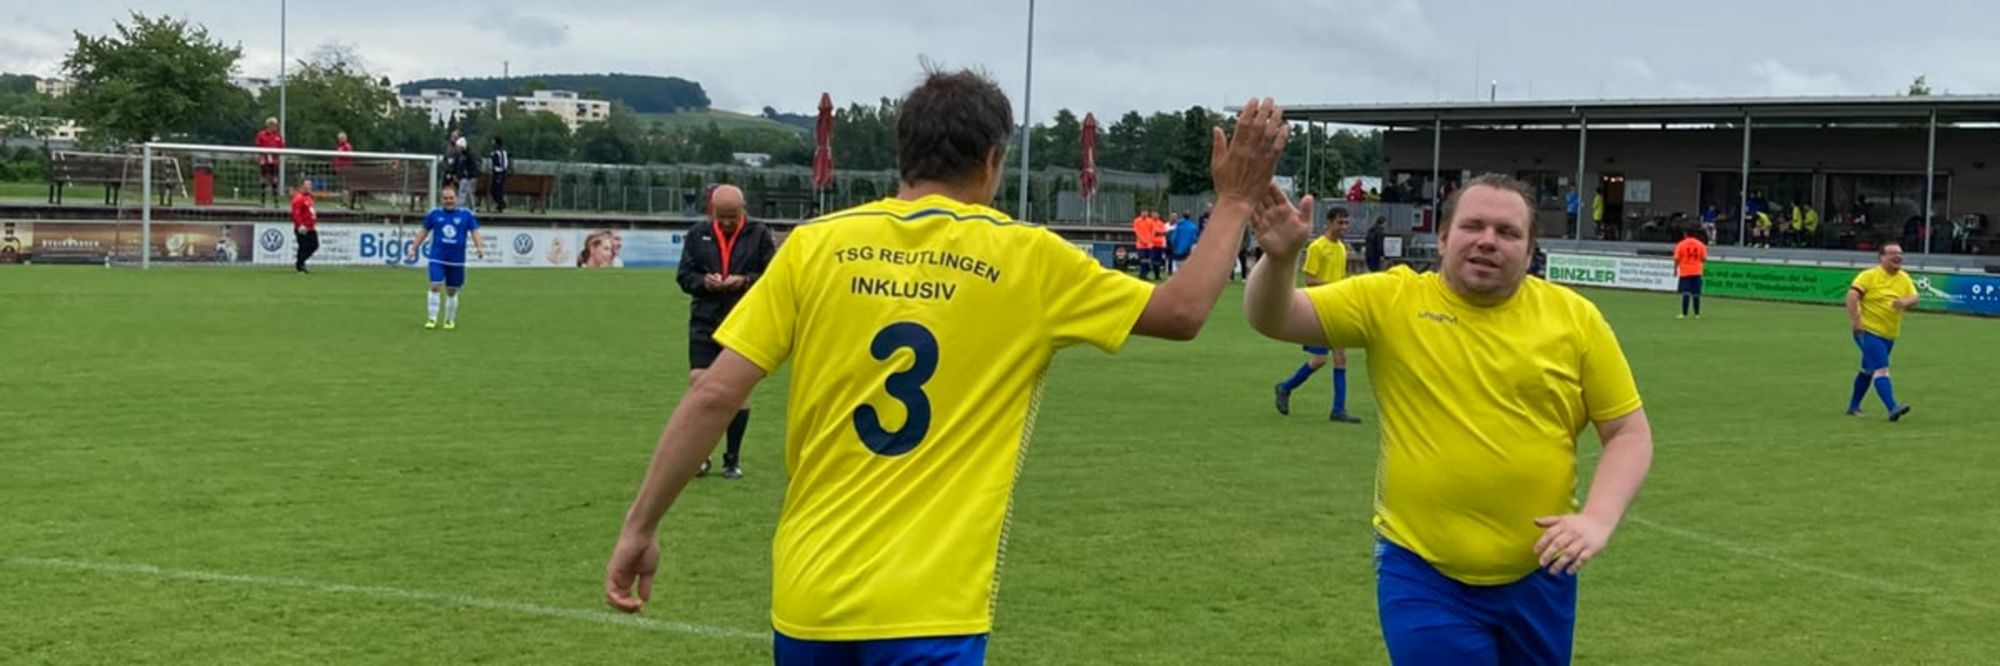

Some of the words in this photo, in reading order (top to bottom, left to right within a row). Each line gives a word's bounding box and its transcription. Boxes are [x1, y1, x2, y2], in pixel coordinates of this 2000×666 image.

[835, 247, 874, 264] TSG
[879, 248, 1001, 284] REUTLINGEN
[1686, 247, 1699, 261] 14
[1549, 267, 1616, 284] BINZLER
[851, 276, 956, 301] INKLUSIV
[853, 321, 939, 456] 3
